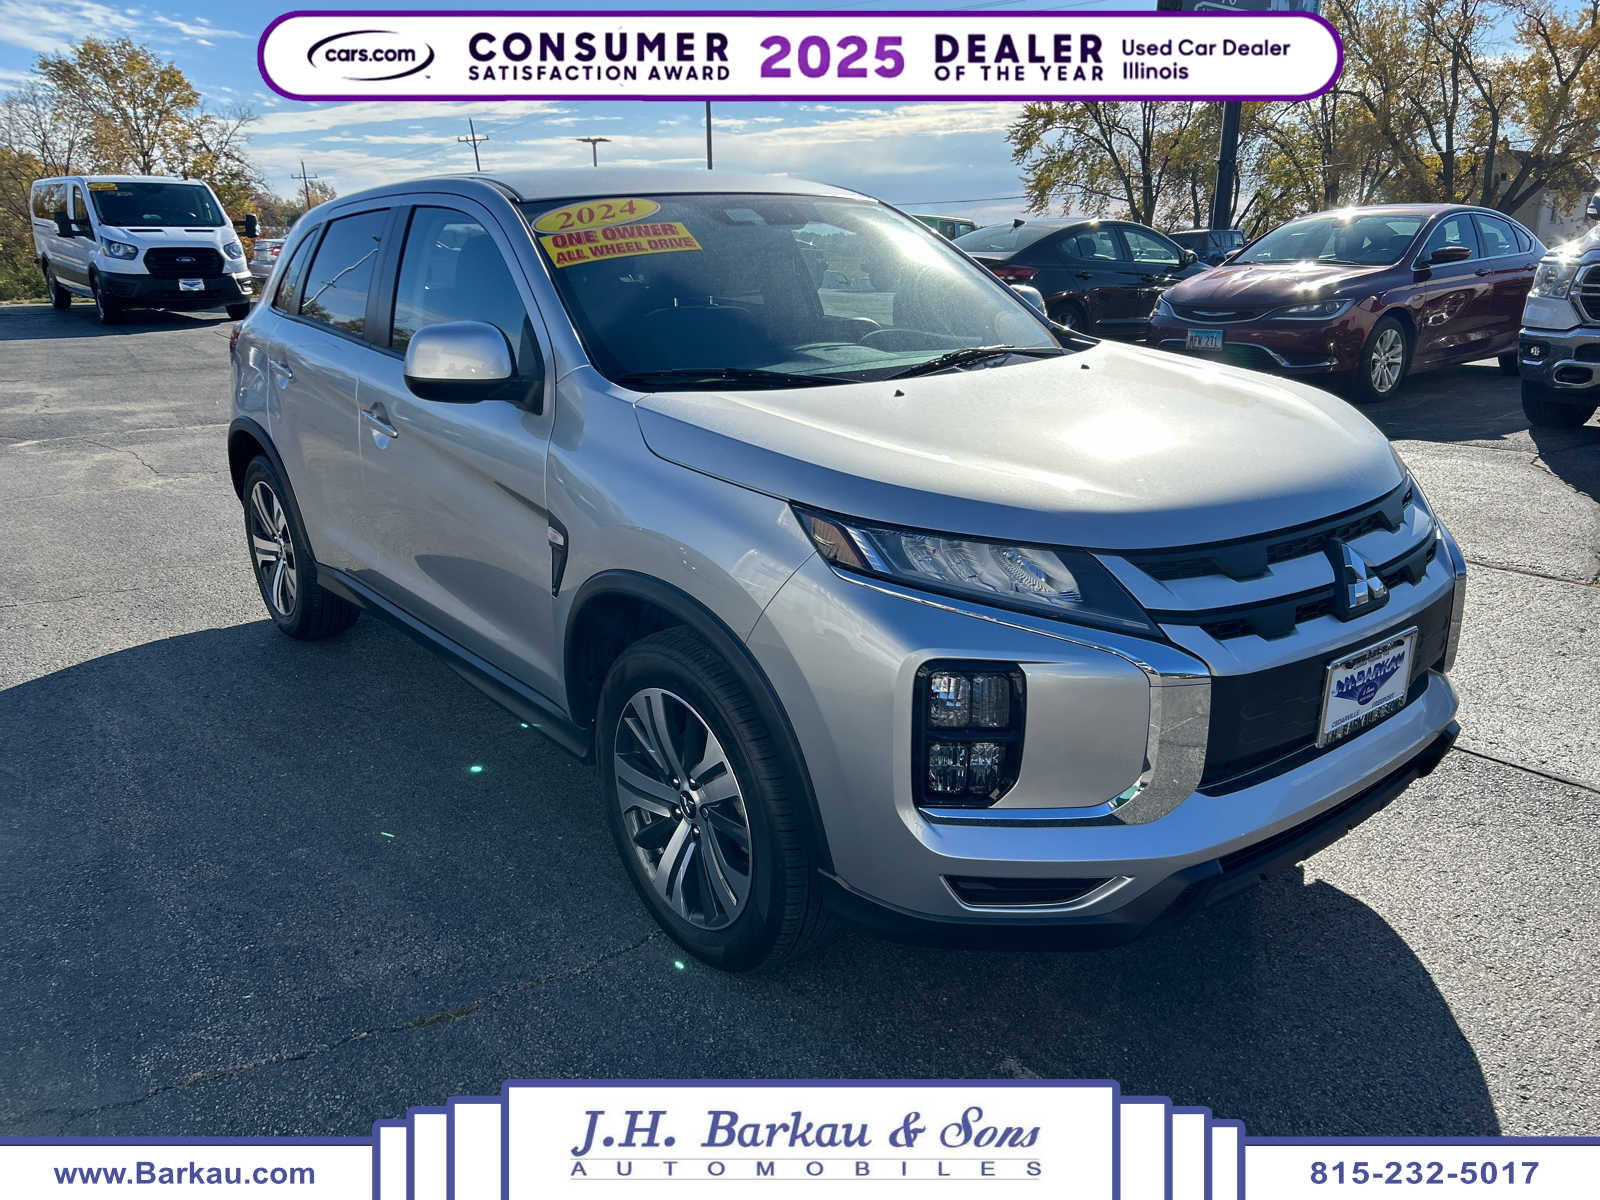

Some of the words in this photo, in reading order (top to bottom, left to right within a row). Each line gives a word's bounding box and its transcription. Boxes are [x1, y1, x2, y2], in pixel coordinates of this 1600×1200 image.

[557, 200, 637, 230] 2024
[552, 230, 599, 249] ONE
[602, 223, 680, 241] OWNER
[556, 250, 590, 264] ALL
[590, 241, 648, 257] WHEEL
[648, 237, 697, 249] DRIVE
